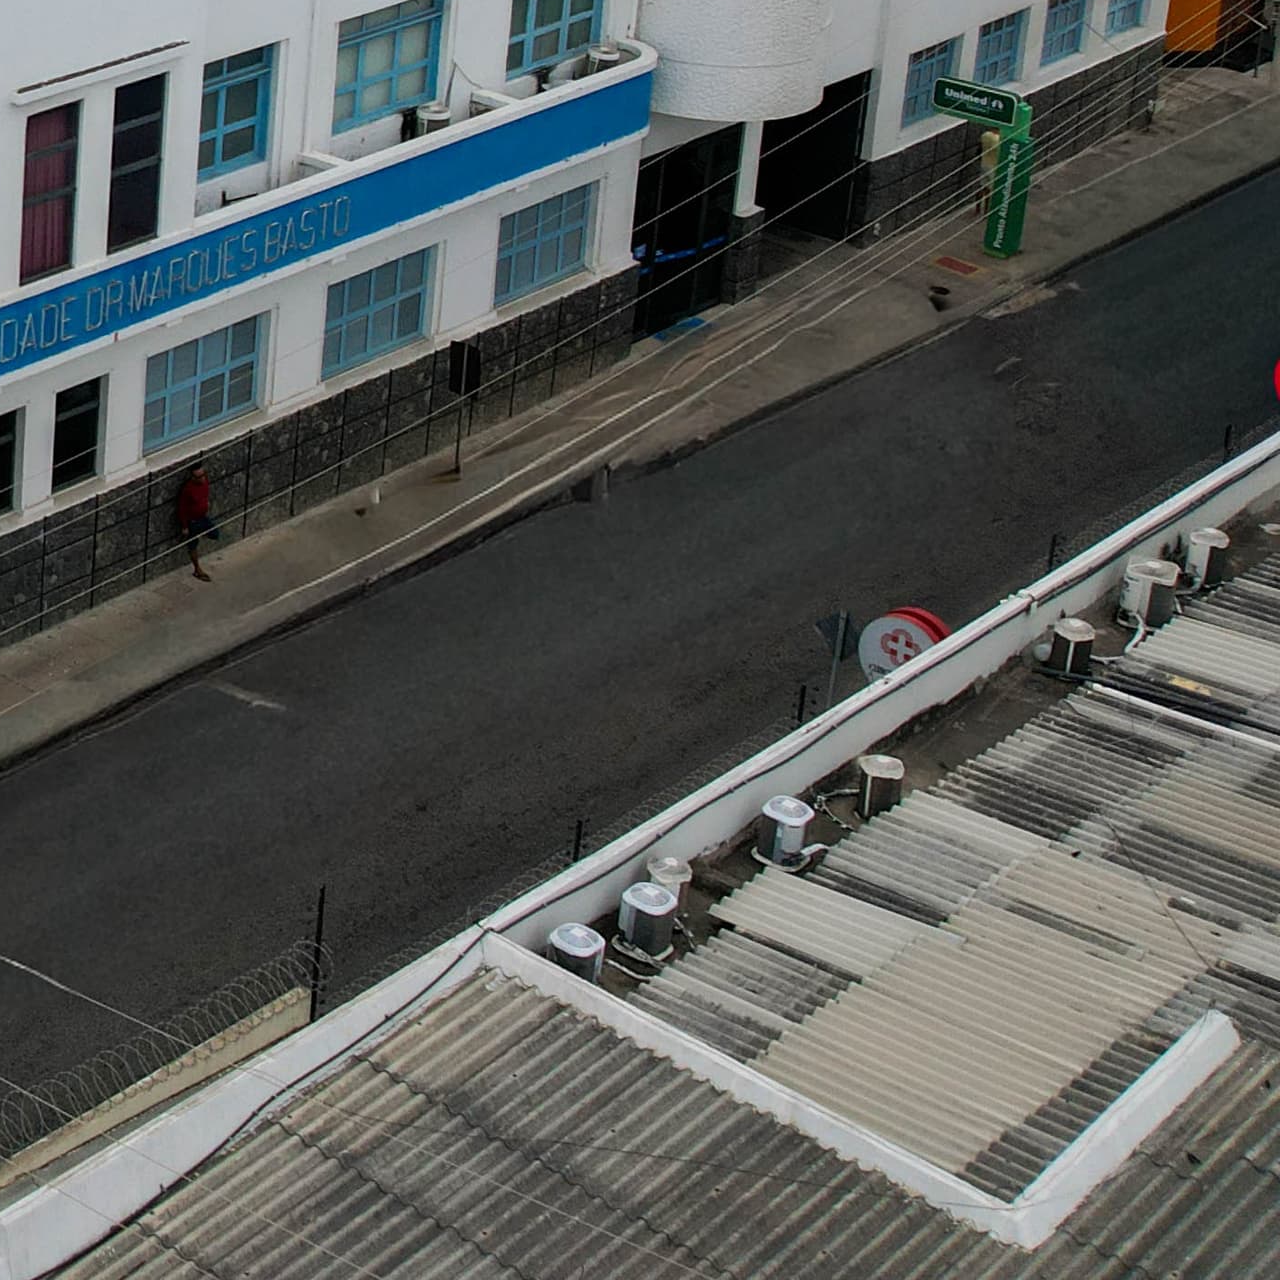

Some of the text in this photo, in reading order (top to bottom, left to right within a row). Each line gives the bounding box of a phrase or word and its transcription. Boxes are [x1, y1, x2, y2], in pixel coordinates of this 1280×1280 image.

[945, 87, 989, 106] Unimed
[85, 280, 123, 331] DR
[128, 230, 257, 313] MARQUES
[264, 195, 351, 263] BASTO
